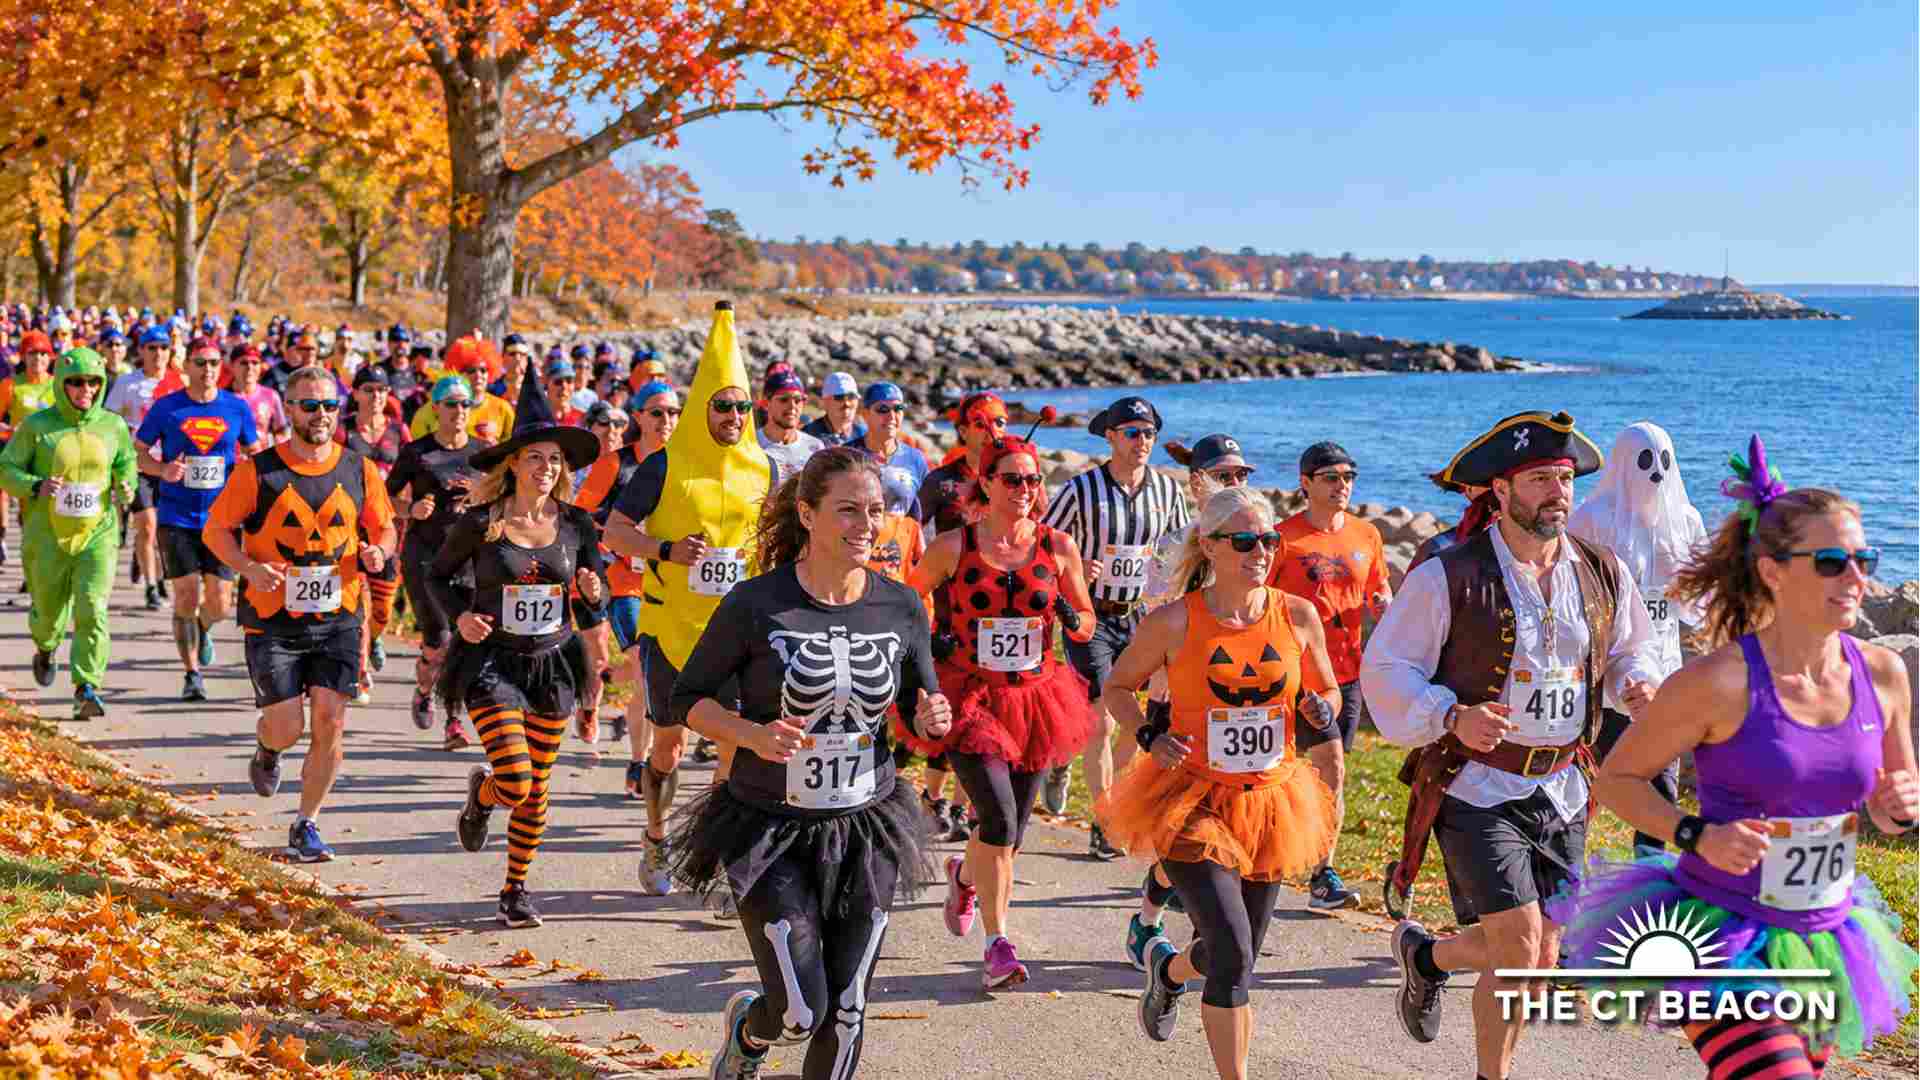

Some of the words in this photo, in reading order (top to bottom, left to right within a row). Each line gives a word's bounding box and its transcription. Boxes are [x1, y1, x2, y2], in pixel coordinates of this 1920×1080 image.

[192, 466, 218, 481] 322
[701, 561, 737, 583] 693
[1111, 558, 1144, 577] 602
[295, 579, 333, 601] 284
[515, 600, 553, 622] 612
[1643, 599, 1668, 621] 58
[991, 633, 1030, 657] 521
[1525, 688, 1575, 720] 418
[1223, 725, 1273, 756] 390
[804, 755, 861, 789] 317
[1783, 841, 1845, 886] 276
